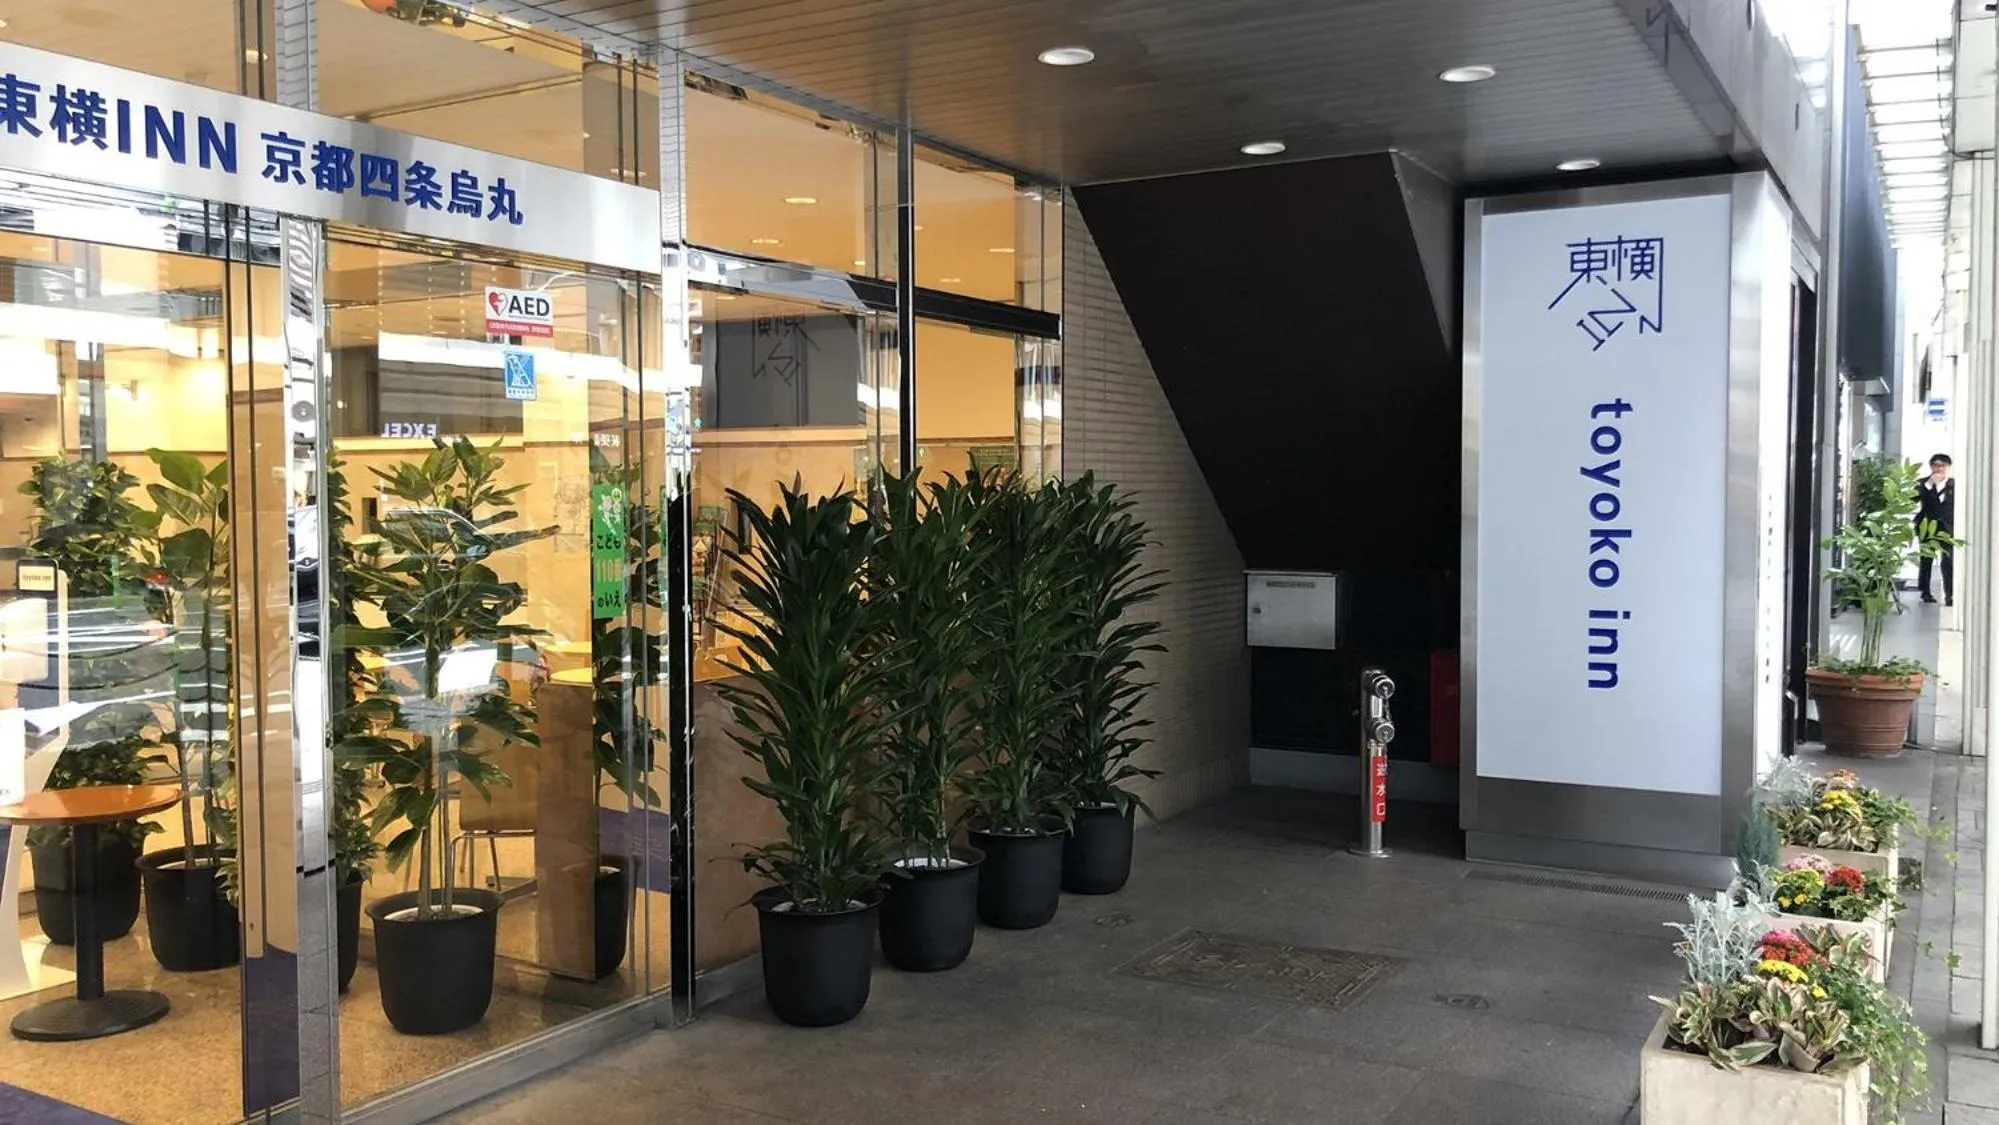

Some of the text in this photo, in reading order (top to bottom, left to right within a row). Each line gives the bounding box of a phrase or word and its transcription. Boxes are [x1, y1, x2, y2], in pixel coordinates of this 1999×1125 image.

[260, 131, 524, 226] 京都四条烏丸
[508, 295, 550, 316] AED
[596, 534, 622, 549] こども
[1580, 397, 1633, 689] toyoko inn
